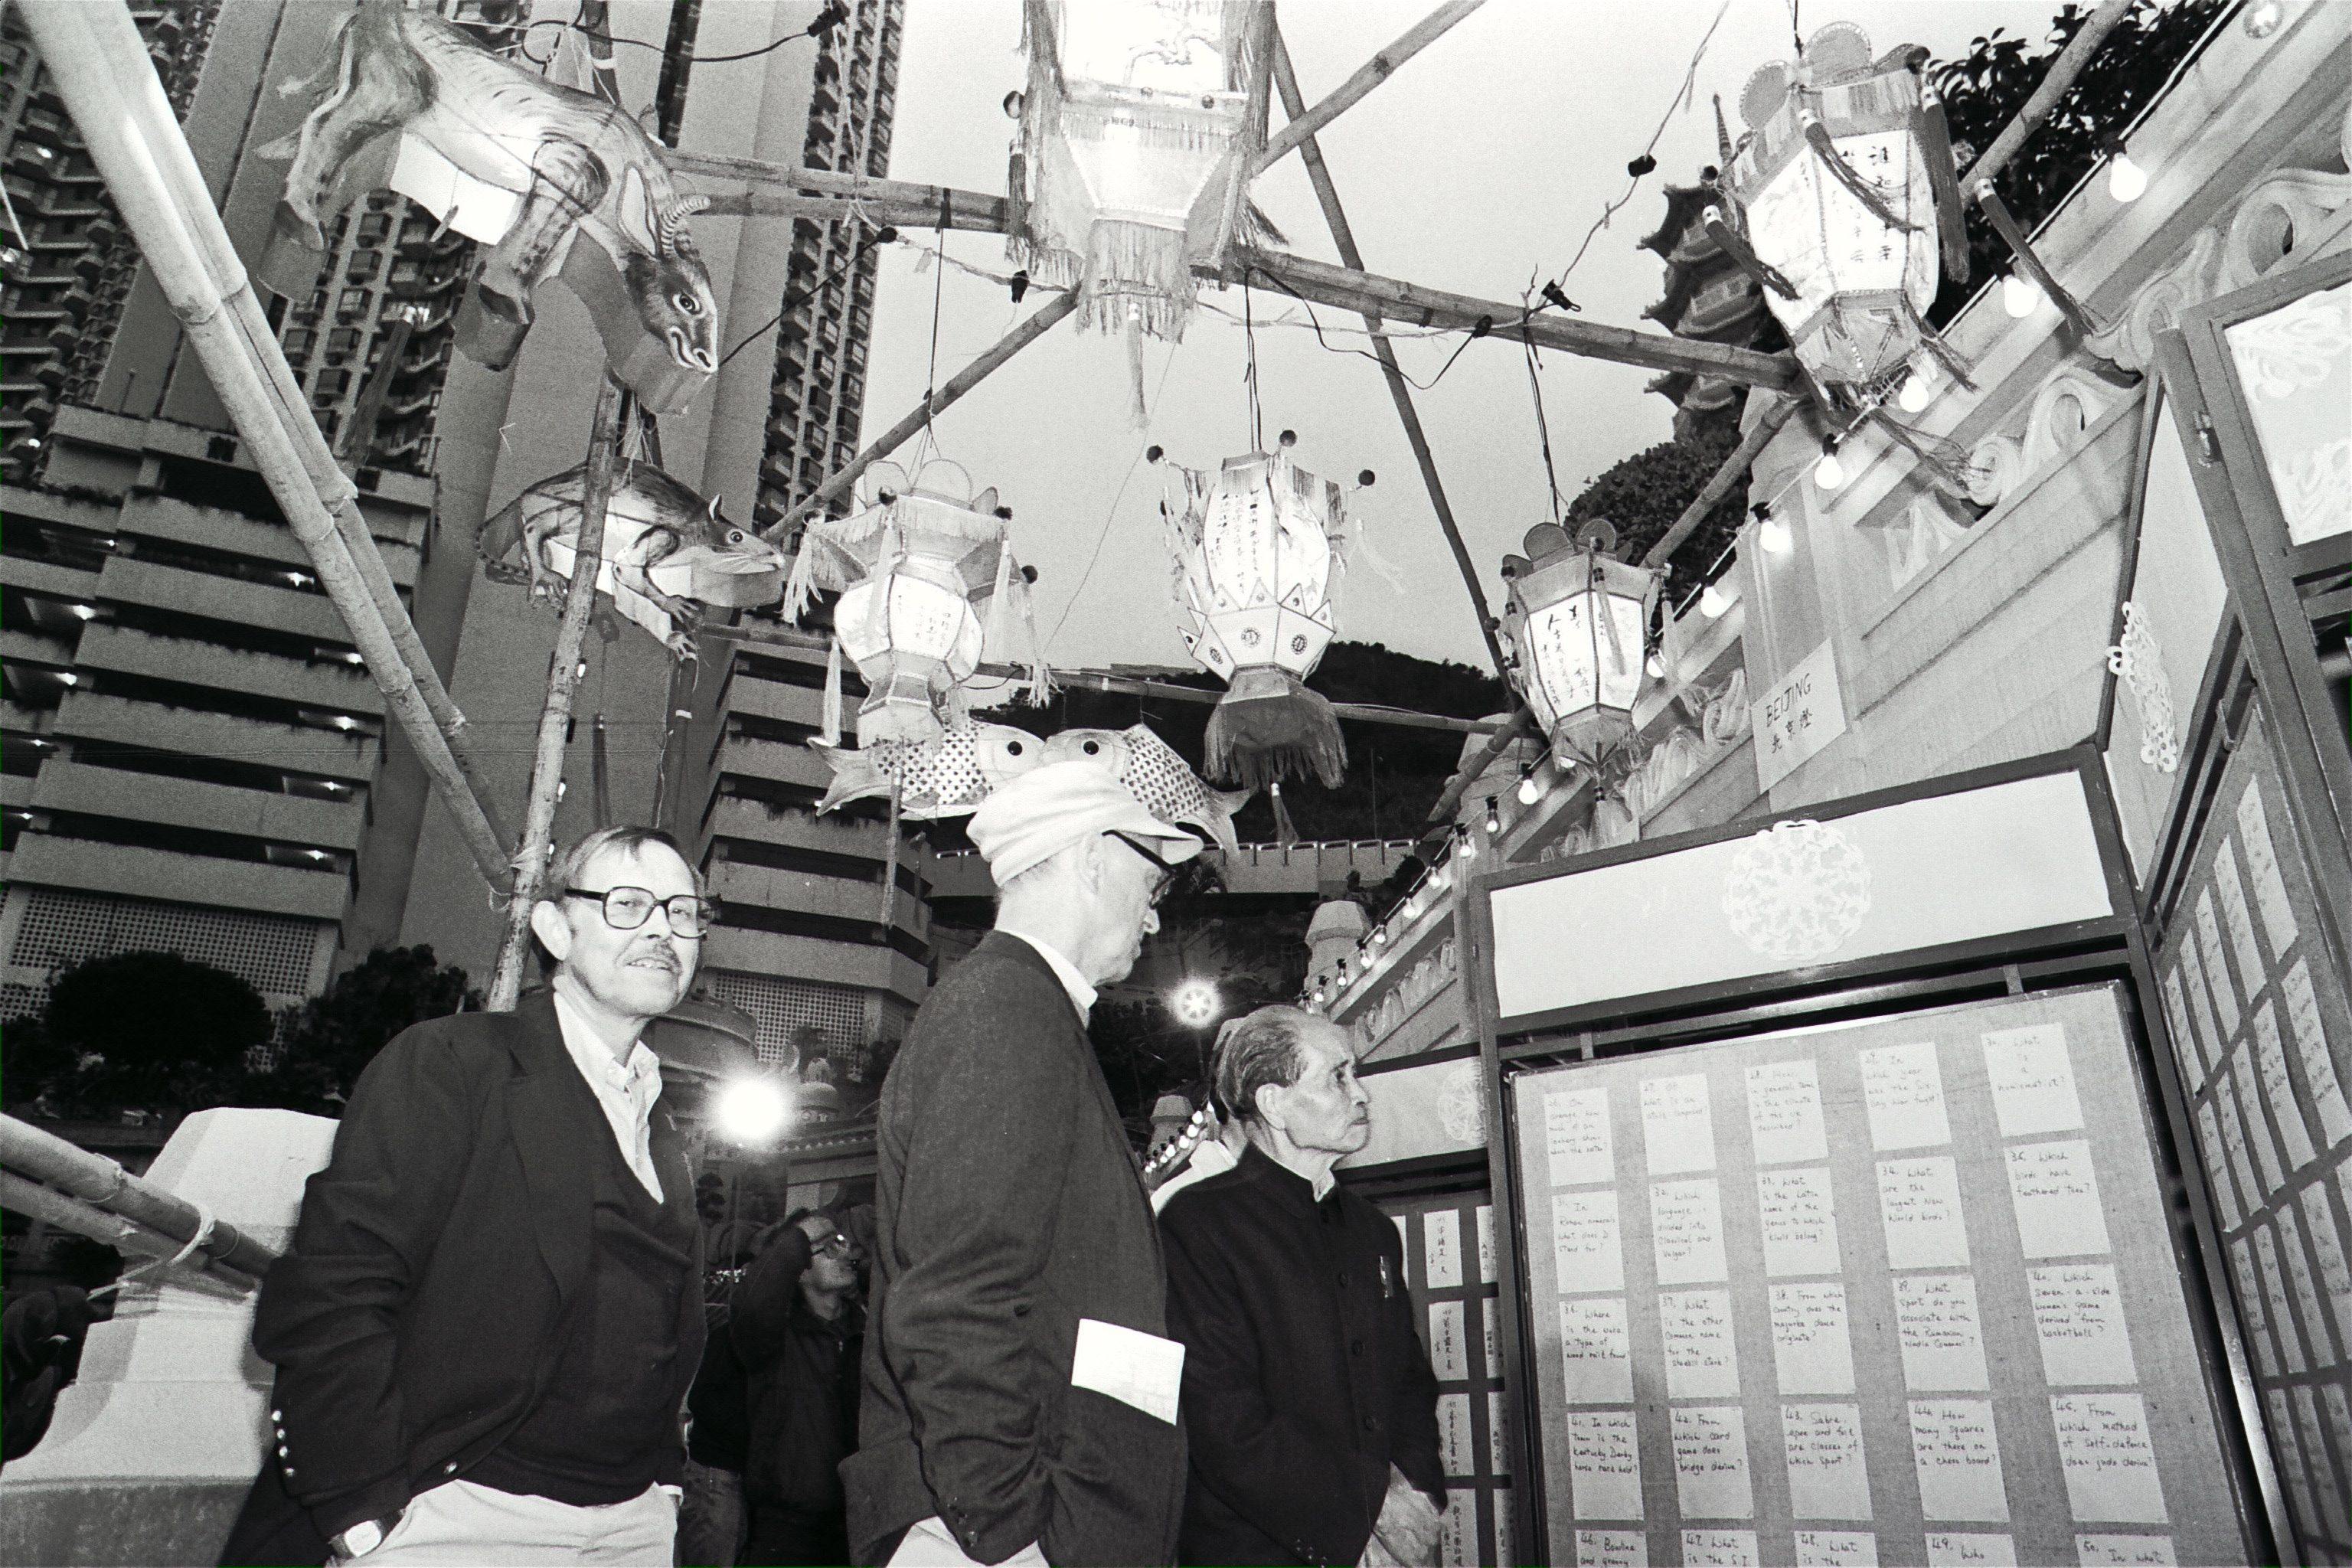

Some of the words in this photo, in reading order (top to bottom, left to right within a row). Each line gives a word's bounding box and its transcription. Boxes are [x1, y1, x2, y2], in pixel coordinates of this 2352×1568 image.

[1766, 672, 1811, 728] BEIJING
[2049, 1168, 2072, 1178] have
[1797, 1290, 1816, 1300] From
[1823, 1289, 1843, 1299] which
[1933, 1297, 1944, 1306] do
[1950, 1299, 1966, 1308] you
[1827, 1305, 1842, 1313] the
[2074, 1301, 2100, 1316] game
[1585, 1310, 1609, 1319] Where
[1900, 1312, 1942, 1322] associate
[2038, 1314, 2070, 1325] derived
[2080, 1312, 2105, 1325] from
[1680, 1318, 1694, 1327] the
[1702, 1316, 1723, 1325] other
[1902, 1327, 1919, 1338] the
[1574, 1338, 1593, 1348] type
[1600, 1337, 1607, 1345] of
[1942, 1410, 1965, 1419] How
[2086, 1402, 2115, 1417] From
[1592, 1417, 1602, 1428] In
[1609, 1419, 1630, 1428] which
[1697, 1413, 1720, 1425] From
[1815, 1426, 1831, 1436] and
[2102, 1419, 2137, 1432] method
[1915, 1425, 1939, 1439] many
[1597, 1433, 1605, 1442] is
[1612, 1434, 1626, 1444] the
[2063, 1434, 2073, 1449] of
[1847, 1439, 1858, 1452] of
[1917, 1442, 1933, 1451] are
[1942, 1440, 1966, 1451] there
[1610, 1446, 1632, 1462] Derby
[1677, 1449, 1697, 1462] game
[1703, 1446, 1721, 1455] does
[1574, 1462, 1592, 1472] horse
[1920, 1458, 1928, 1466] a
[2066, 1454, 2089, 1466] does
[2096, 1457, 2117, 1471] judo
[1679, 1460, 1704, 1476] bridge
[1580, 1557, 1595, 1566] and
[1687, 1553, 1698, 1563] is
[1705, 1554, 1723, 1565] the
[1802, 1553, 1813, 1564] is
[1821, 1556, 1841, 1566] the
